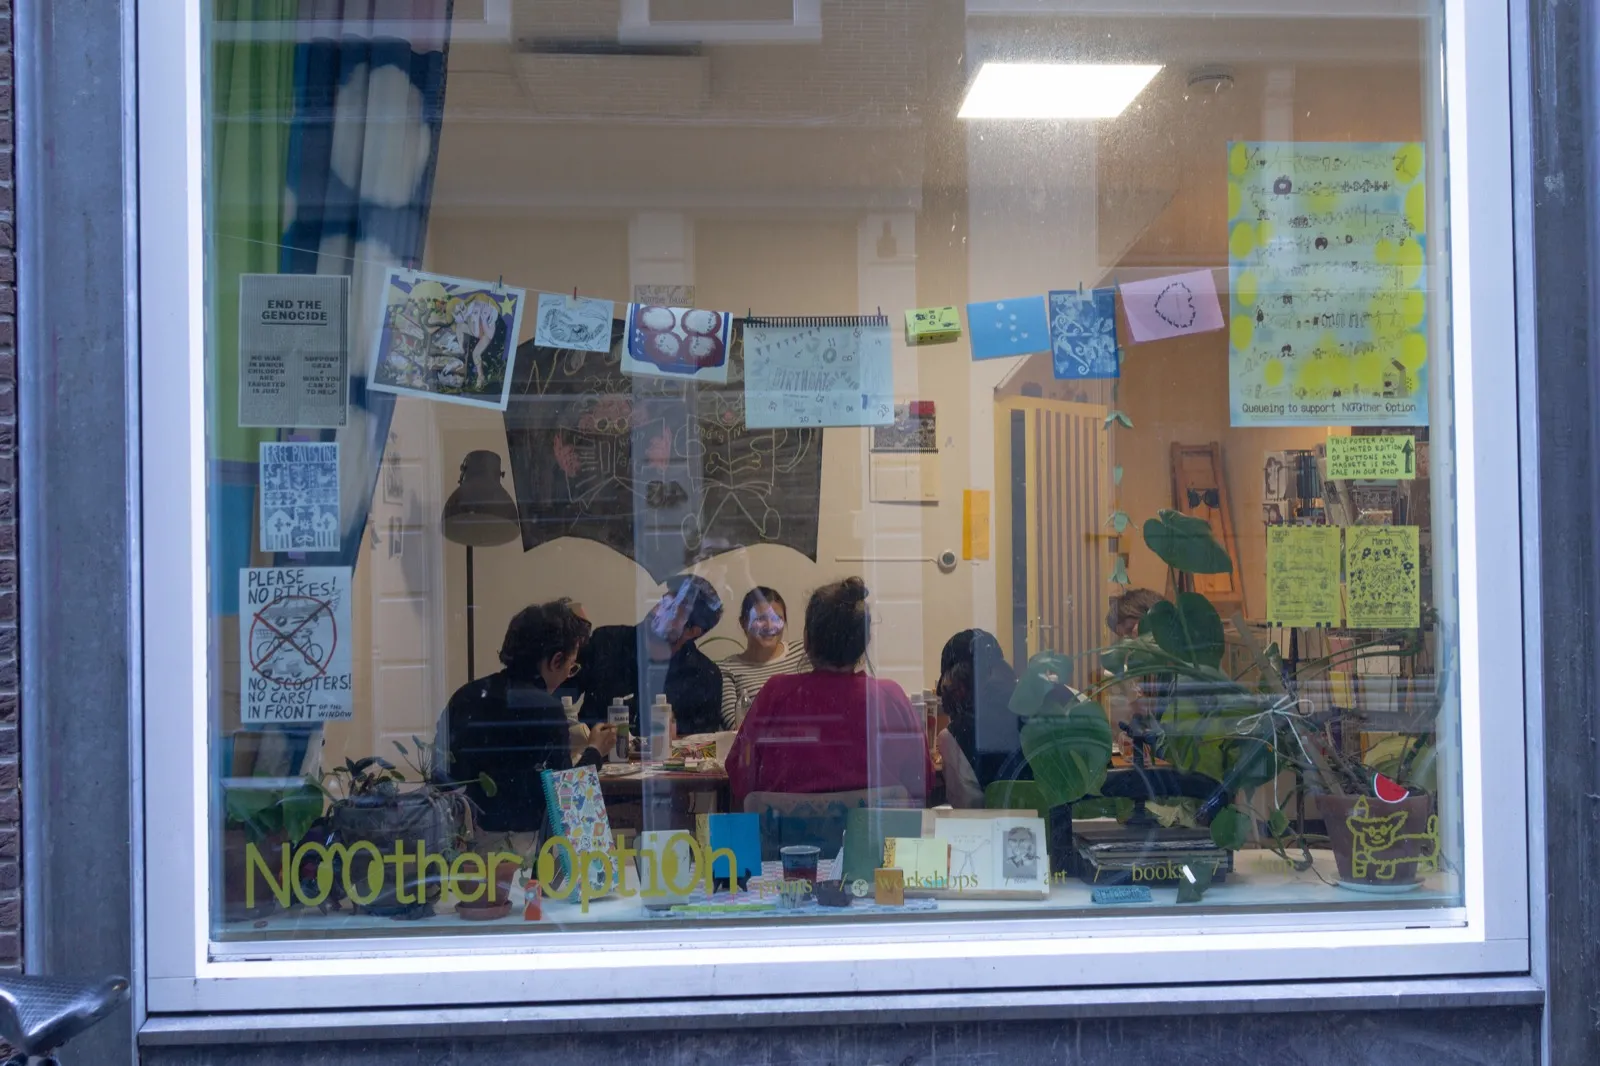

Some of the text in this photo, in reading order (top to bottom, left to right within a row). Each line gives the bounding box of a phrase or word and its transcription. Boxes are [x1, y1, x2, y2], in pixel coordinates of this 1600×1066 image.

[268, 300, 322, 310] END THE
[262, 311, 328, 320] GENOCIDE
[1242, 403, 1285, 416] Queueing
[1288, 404, 1298, 413] to
[1301, 404, 1336, 416] support
[1386, 402, 1416, 415] Option
[1330, 437, 1347, 445] THIS
[266, 444, 288, 463] FREE
[1342, 445, 1372, 453] LIMITED
[1375, 444, 1403, 452] EDITION
[1344, 454, 1378, 462] BUTTONS
[1372, 537, 1393, 546] March
[248, 569, 304, 588] PLEASE
[248, 576, 336, 604] NO BIKES!
[248, 674, 352, 692] NO SCOOTERS!
[248, 690, 312, 704] NO CARS!
[248, 704, 260, 718] IN
[264, 704, 317, 719] FRONT
[876, 870, 978, 893] workshops
[1043, 870, 1068, 885] art
[1132, 860, 1186, 882] books
